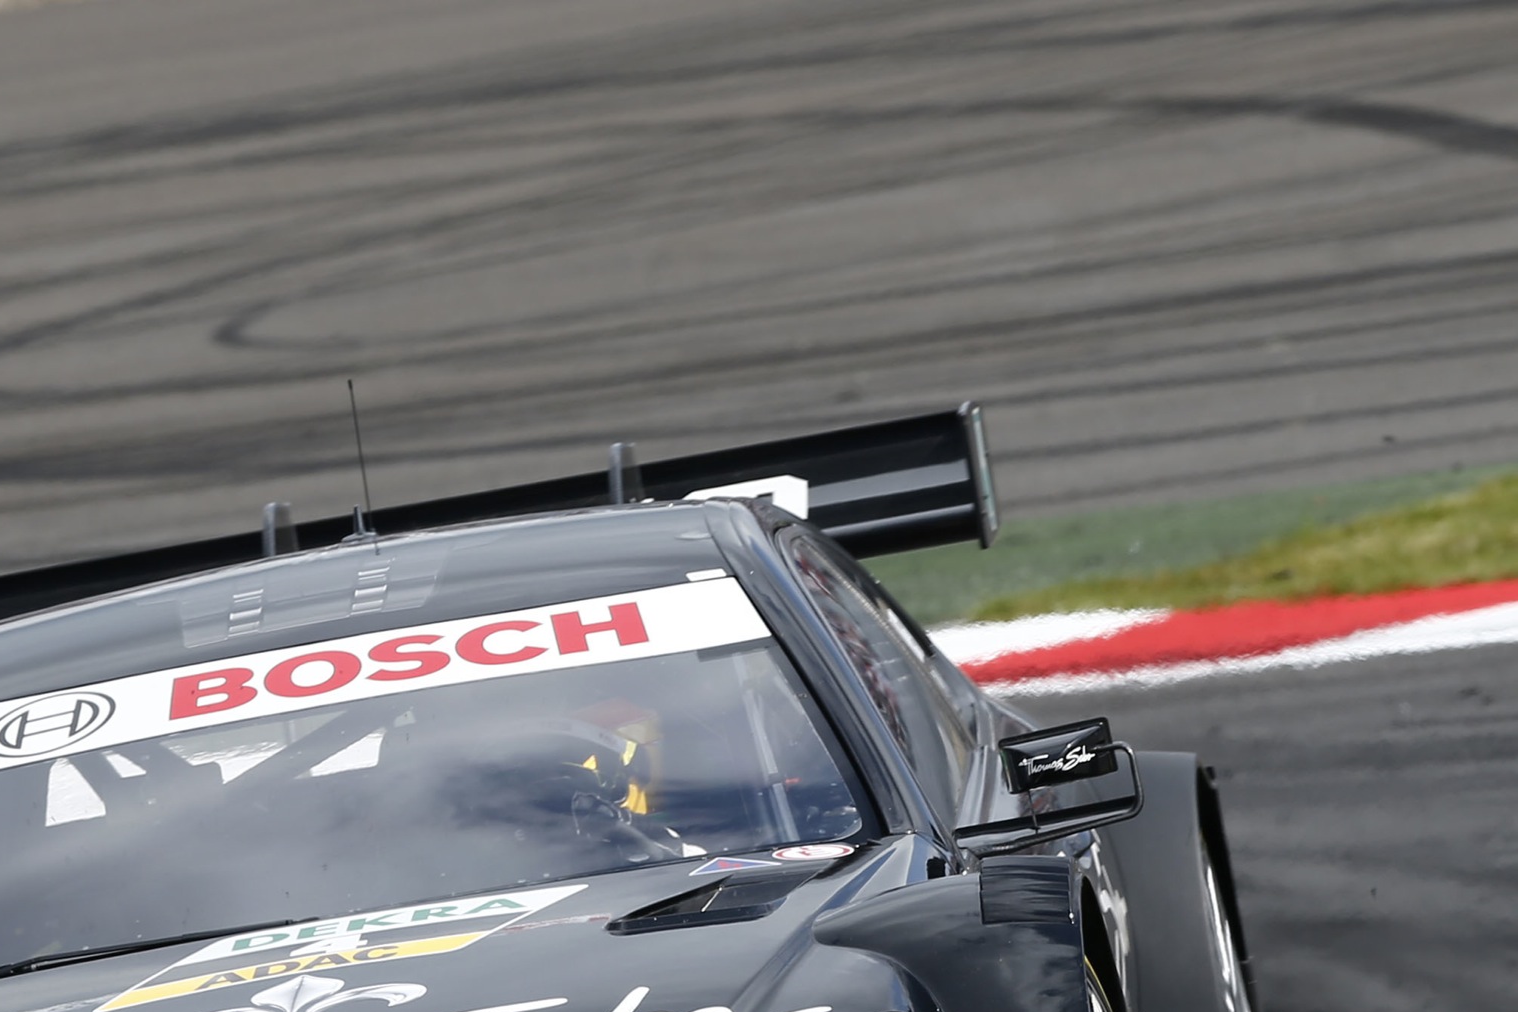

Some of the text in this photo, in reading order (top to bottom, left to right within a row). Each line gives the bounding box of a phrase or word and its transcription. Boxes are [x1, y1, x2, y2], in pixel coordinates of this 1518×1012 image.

[169, 602, 649, 720] BOSCH
[232, 898, 525, 952] DEKRA
[193, 945, 399, 990] ADAC
